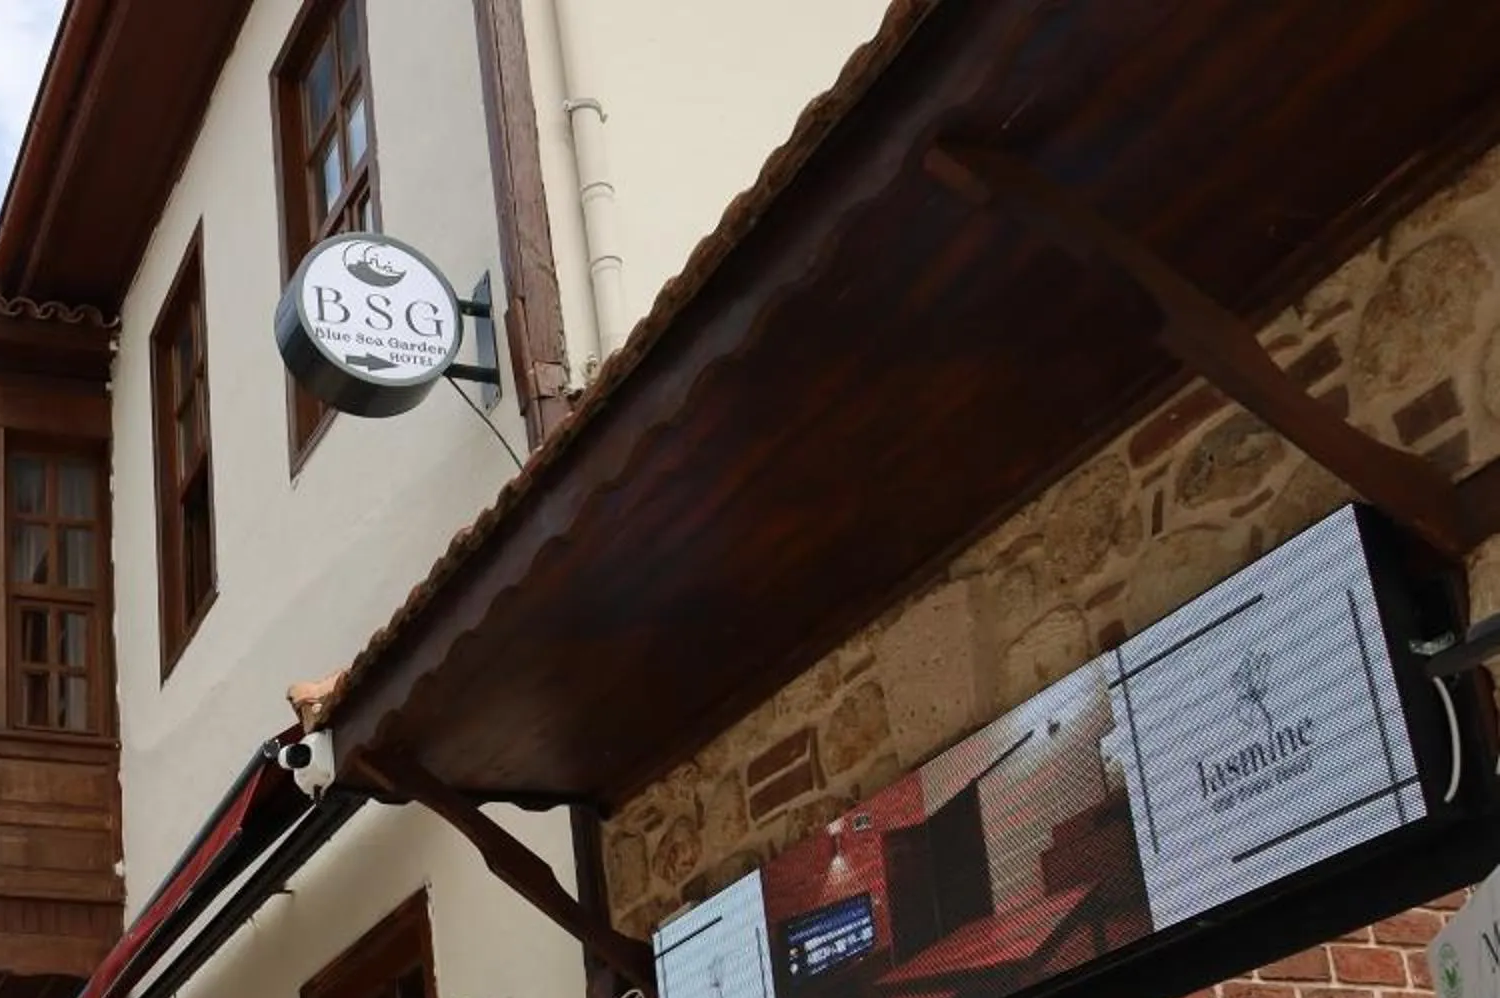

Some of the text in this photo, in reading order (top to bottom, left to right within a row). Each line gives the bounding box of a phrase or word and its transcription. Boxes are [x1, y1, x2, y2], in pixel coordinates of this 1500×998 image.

[313, 285, 444, 338] BSG
[314, 326, 447, 355] Blue Sea Garden
[1197, 718, 1313, 800] Jasmine
